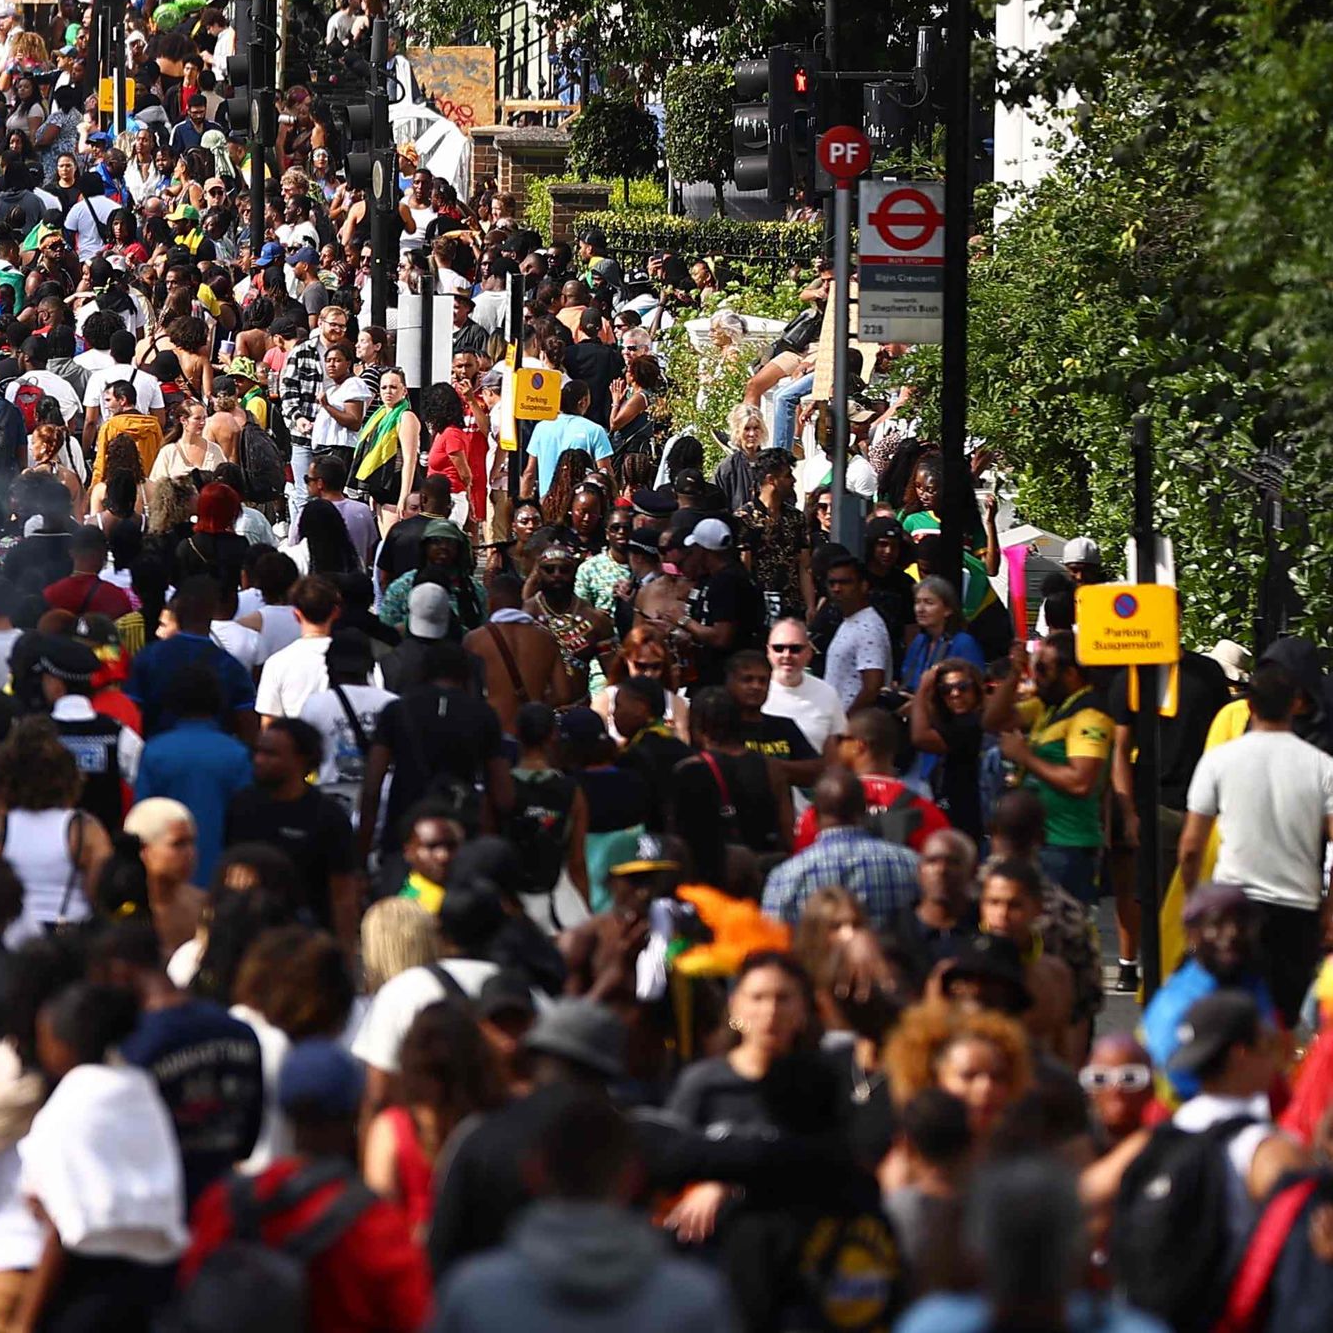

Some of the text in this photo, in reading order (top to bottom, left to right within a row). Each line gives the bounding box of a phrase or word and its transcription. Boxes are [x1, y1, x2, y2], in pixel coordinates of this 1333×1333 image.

[829, 142, 861, 164] PF
[918, 305, 939, 313] Bush
[1104, 627, 1151, 639] Parking
[1093, 640, 1164, 651] Suspension
